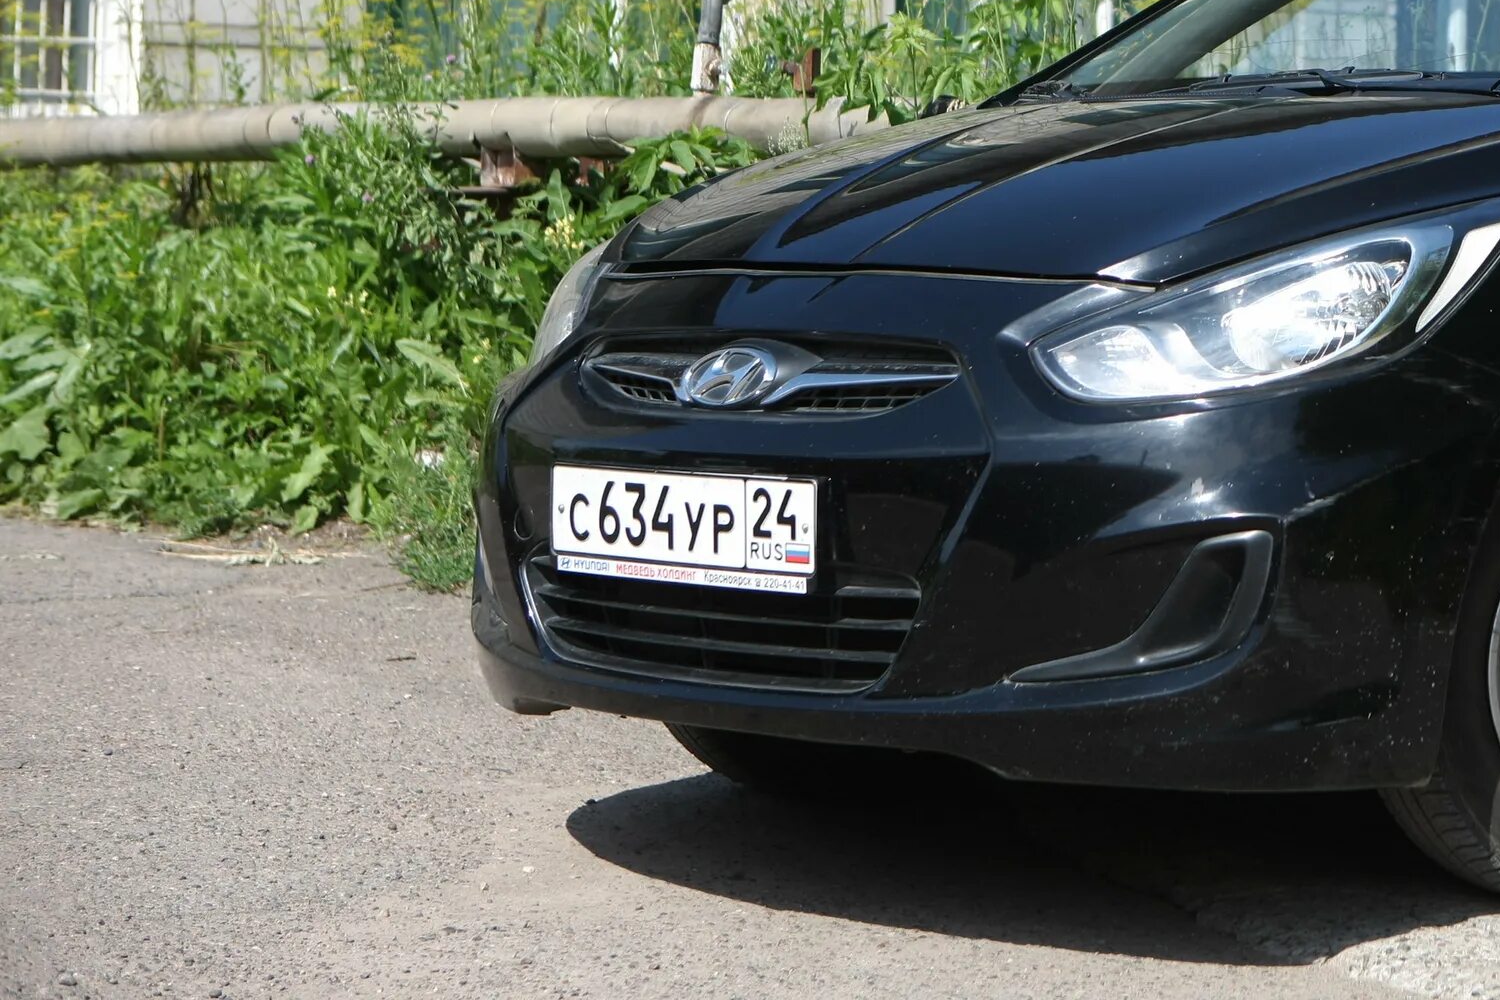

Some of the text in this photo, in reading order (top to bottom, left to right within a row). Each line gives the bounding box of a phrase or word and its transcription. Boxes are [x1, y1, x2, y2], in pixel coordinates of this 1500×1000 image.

[752, 487, 797, 541] 24
[750, 541, 784, 561] RUS
[573, 558, 610, 572] HYUNDAI
[616, 564, 655, 578] МЕДВЕДЬ
